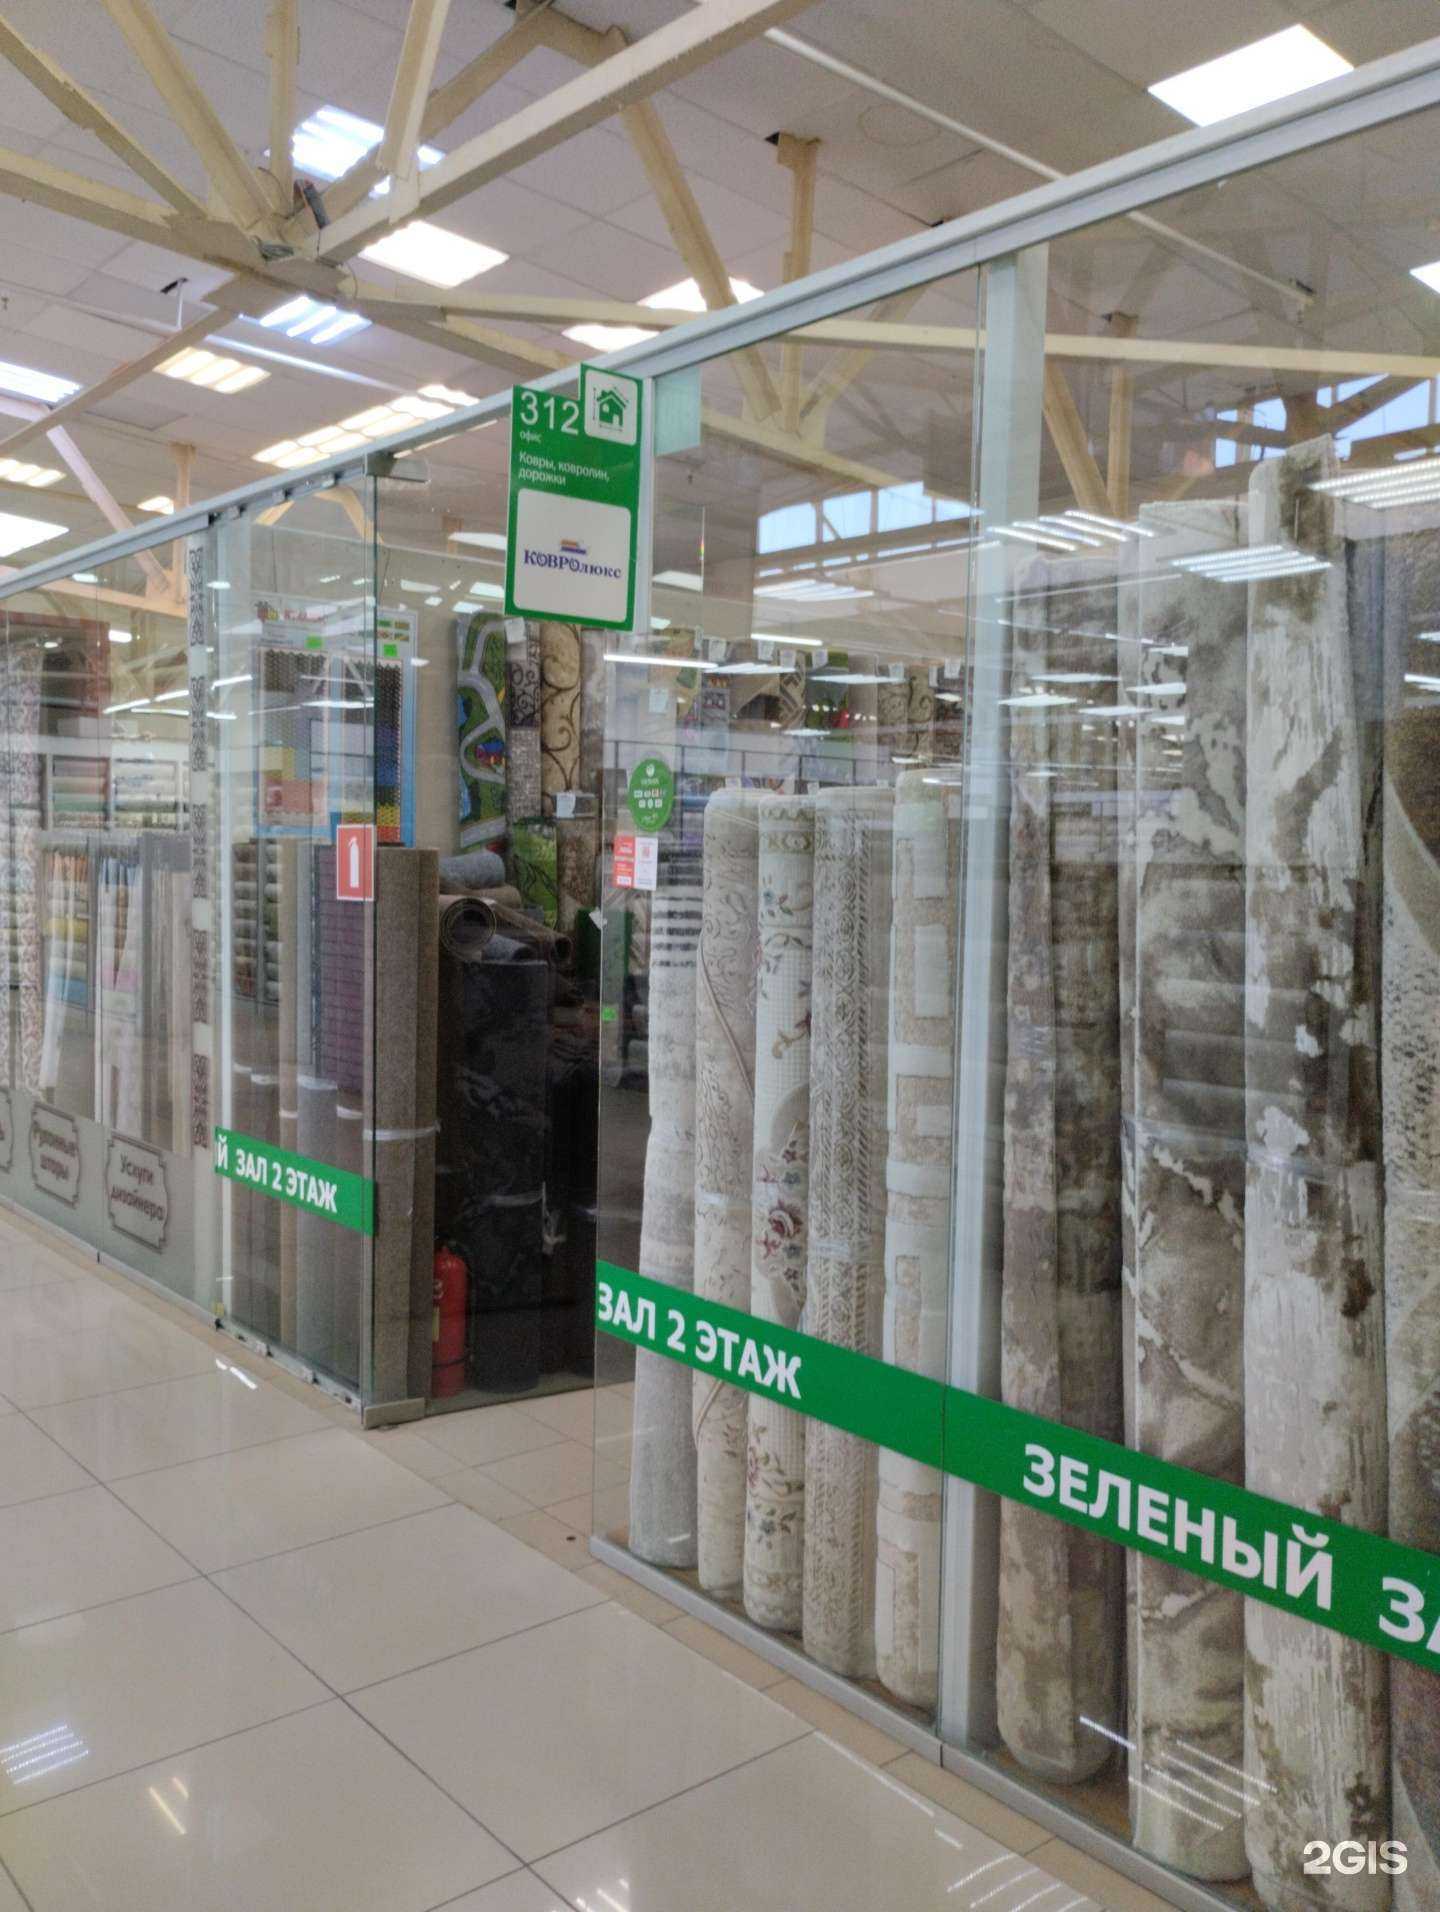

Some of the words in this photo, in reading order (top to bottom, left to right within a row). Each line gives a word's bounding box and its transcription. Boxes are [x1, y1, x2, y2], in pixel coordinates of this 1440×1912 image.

[520, 391, 579, 435] 312
[520, 430, 541, 443] офис
[518, 468, 566, 486] дорожки
[519, 451, 556, 471] Ковры,
[558, 462, 610, 482] ковролин,
[235, 1148, 268, 1185] ЗАЛ
[272, 1161, 282, 1191] 2
[285, 1167, 337, 1213] ЭТАЖ
[598, 1281, 656, 1340] ЗАЛ
[667, 1309, 686, 1353] 2
[695, 1320, 802, 1399] ЭТАЖ
[1023, 1443, 1333, 1611] ЗЕЛЕНЫЙ
[1378, 1576, 1440, 1654] З
